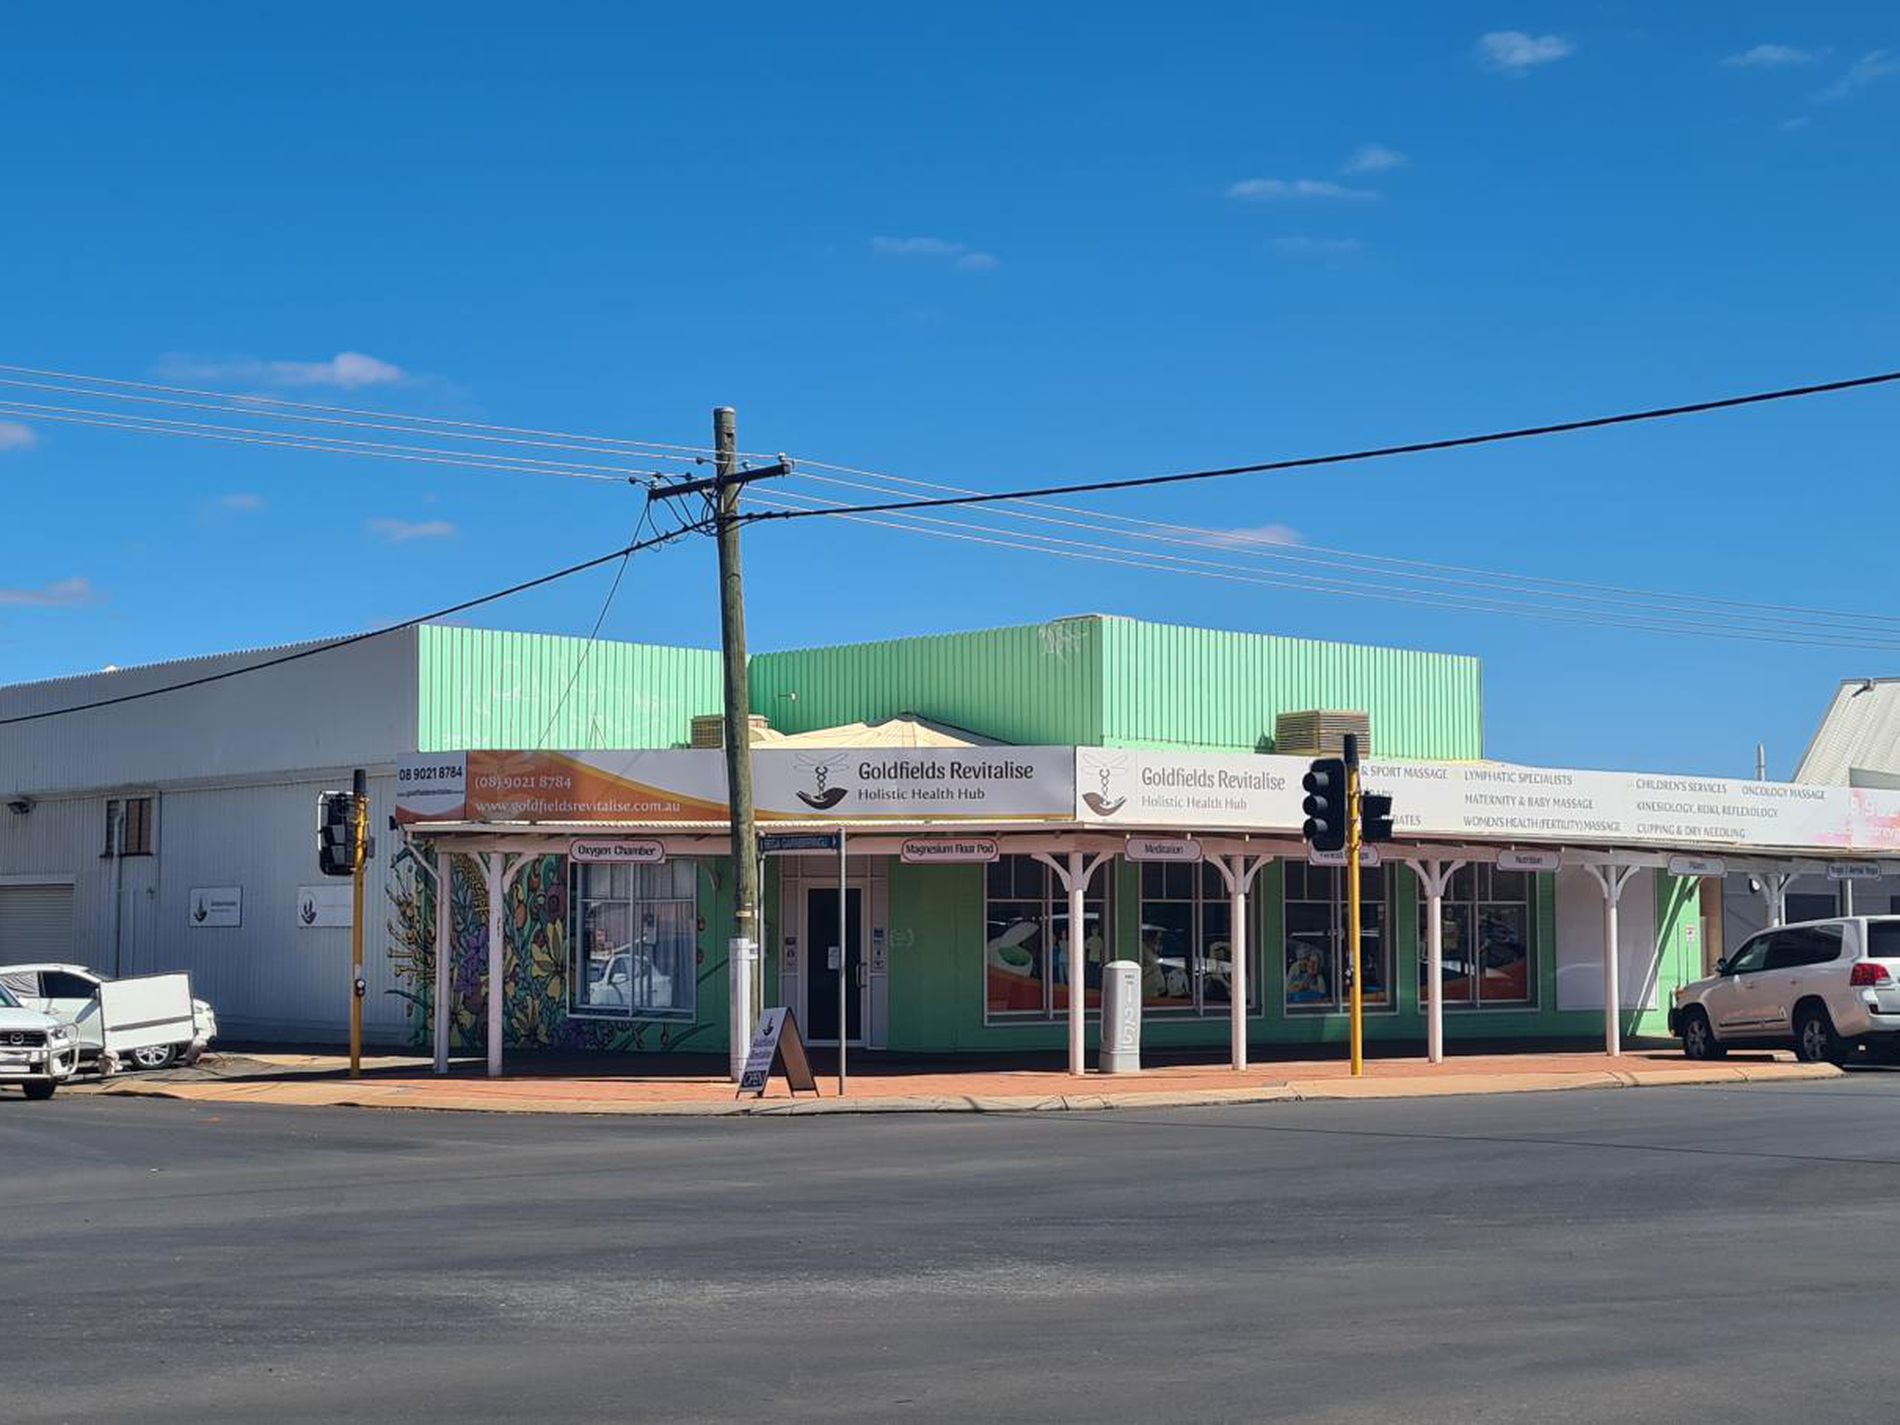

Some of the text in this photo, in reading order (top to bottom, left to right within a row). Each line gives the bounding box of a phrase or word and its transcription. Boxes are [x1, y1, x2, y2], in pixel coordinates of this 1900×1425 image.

[399, 765, 462, 780] 08 9021 8784
[858, 761, 1034, 780] Goldfields Revitalise
[1370, 766, 1401, 777] SPORT
[1404, 767, 1448, 779] MASSAGE
[1465, 770, 1572, 785] LYMPHATIC SPECIALISTS
[475, 776, 572, 790] (08) 9021 8784
[1142, 767, 1286, 791] Goldfields Revitalise
[858, 787, 985, 800] Holistic Health Hub
[1688, 782, 1727, 794] SERVICES
[1742, 785, 1825, 800] ONCOLOGY MASSAGE
[475, 799, 681, 814] www.goldfieldsrevitalise.com.au
[1142, 795, 1247, 810] Holistic Health Hub
[1465, 794, 1594, 809] MATERNITY & BABY MASSAGE
[1584, 819, 1621, 831] MASSAGE
[1637, 823, 1675, 836] CUPPING
[578, 845, 656, 857] Oxygen Chamber
